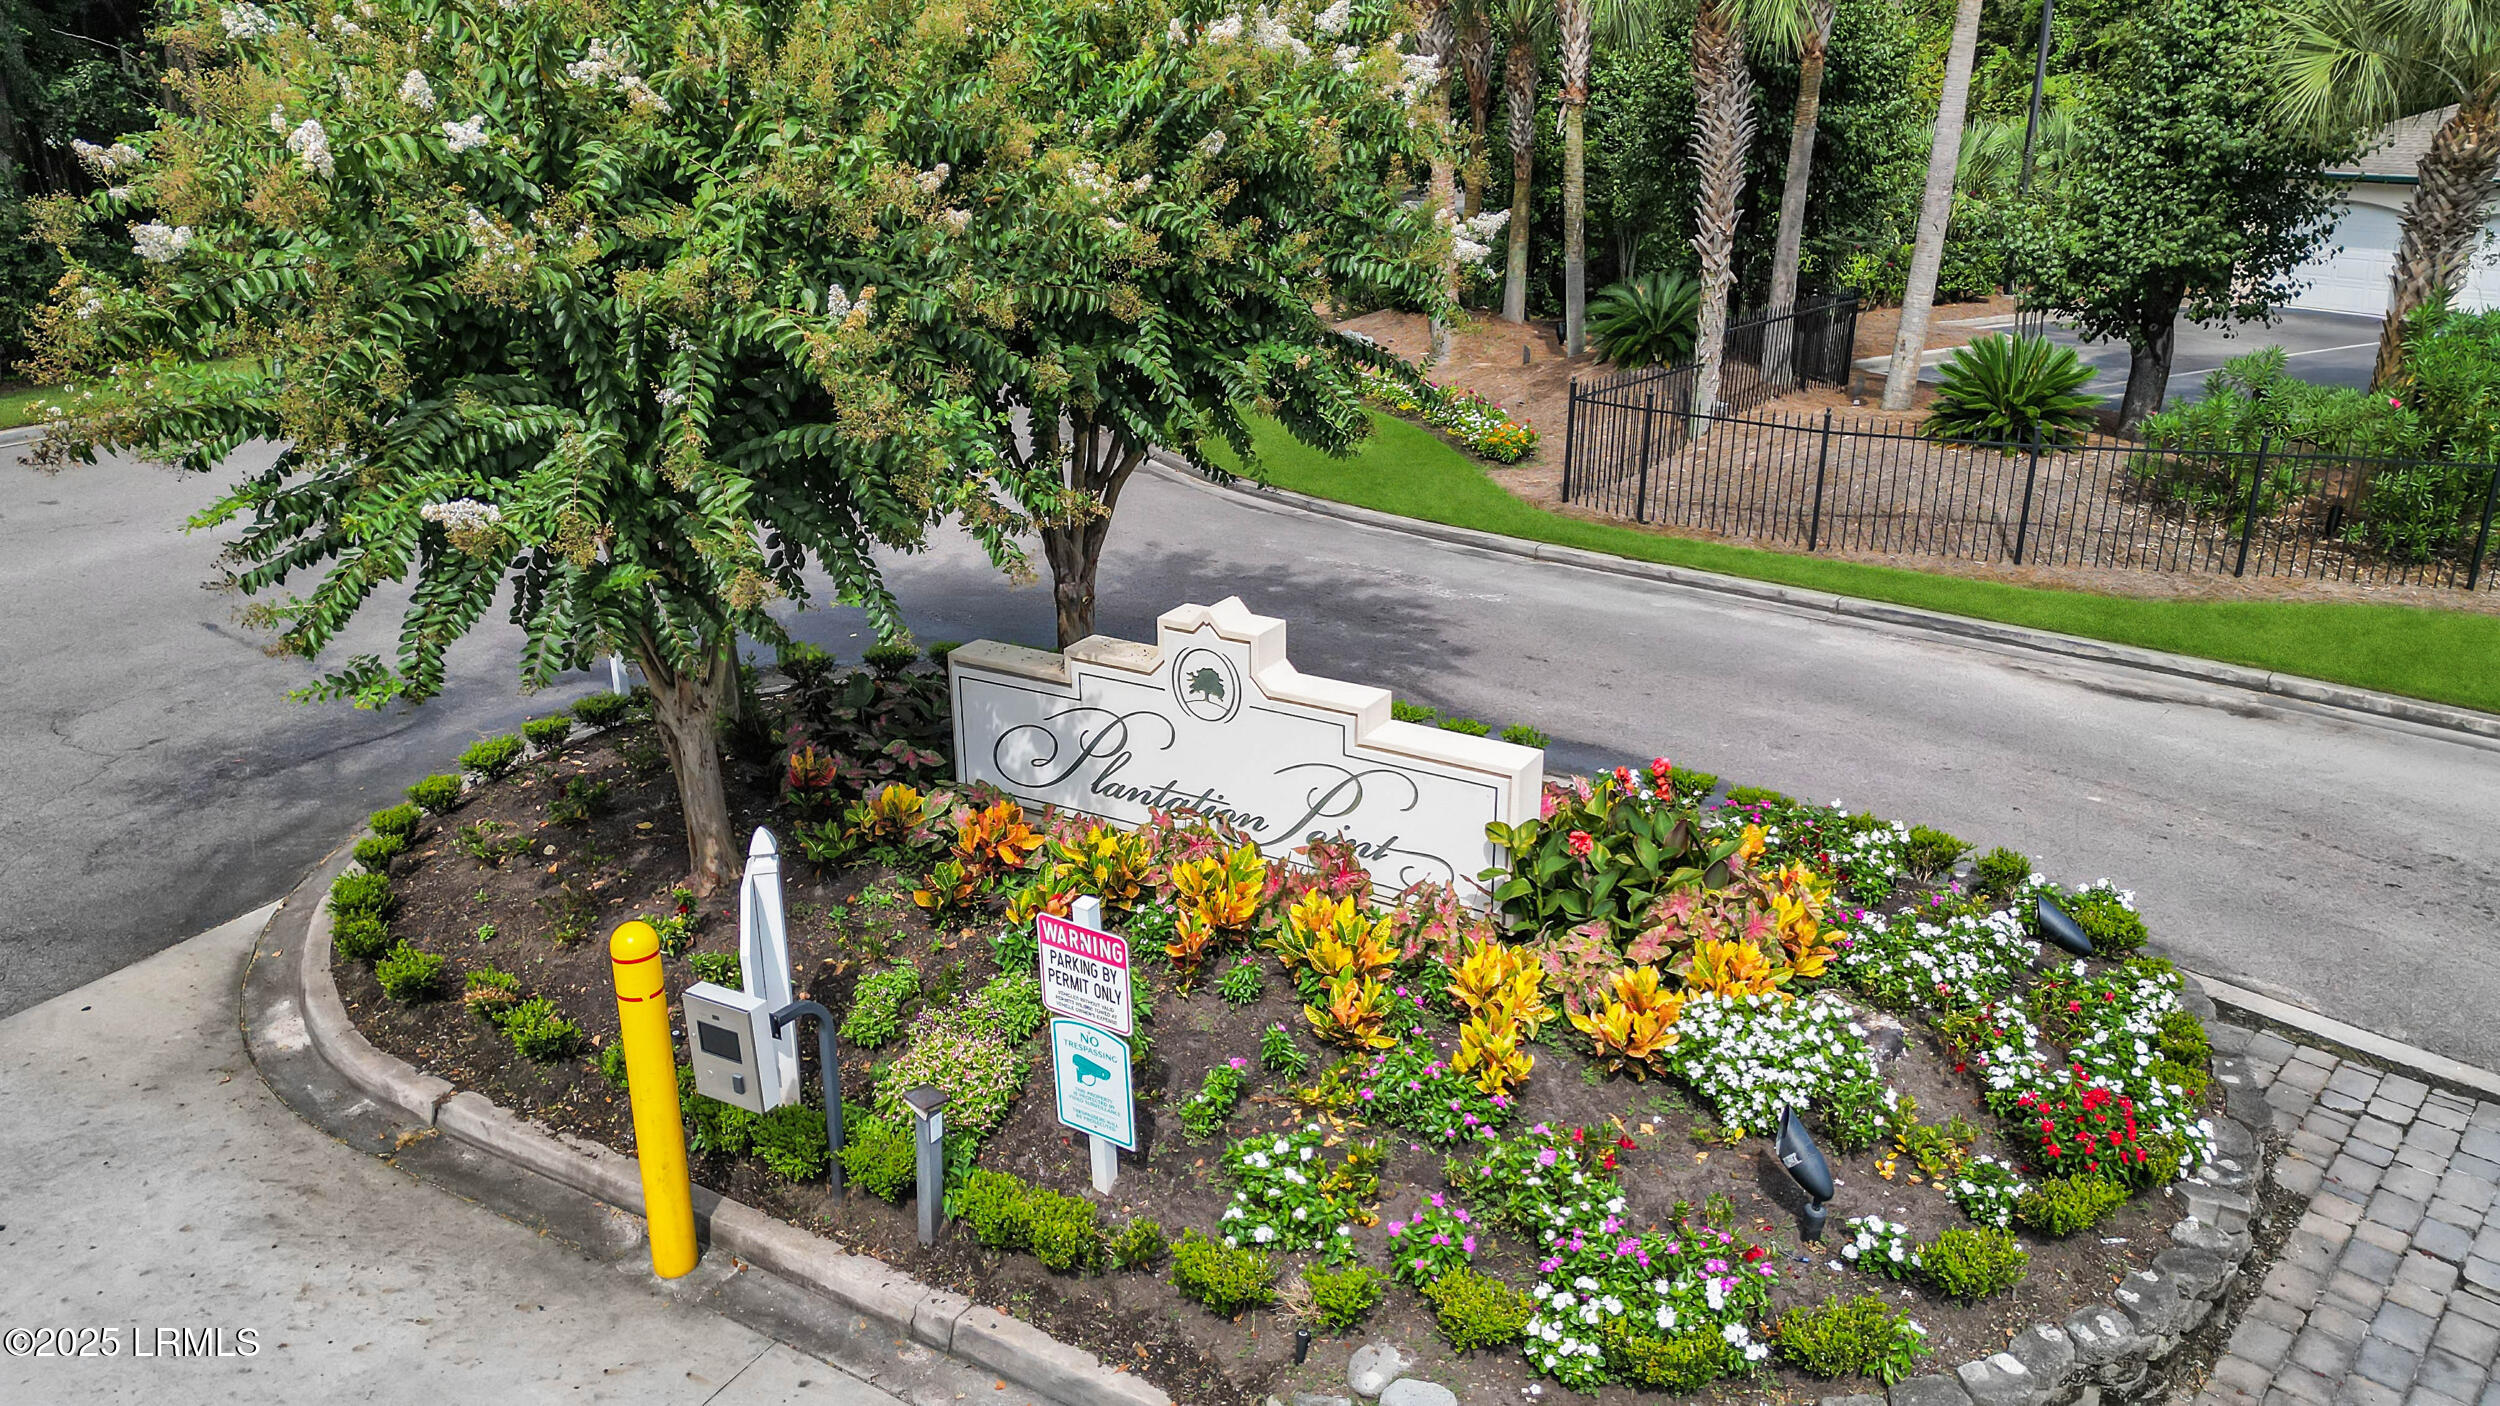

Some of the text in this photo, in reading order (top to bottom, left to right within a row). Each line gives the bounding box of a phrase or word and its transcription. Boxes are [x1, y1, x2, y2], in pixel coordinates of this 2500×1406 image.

[993, 706, 1269, 832] Plantation
[1041, 919, 1123, 964] WARNING
[1049, 949, 1118, 985] PARKING BY
[1048, 968, 1121, 1005] PERMIT ONLY
[1063, 1038, 1118, 1064] TRESPASSING
[1080, 1032, 1099, 1048] NO
